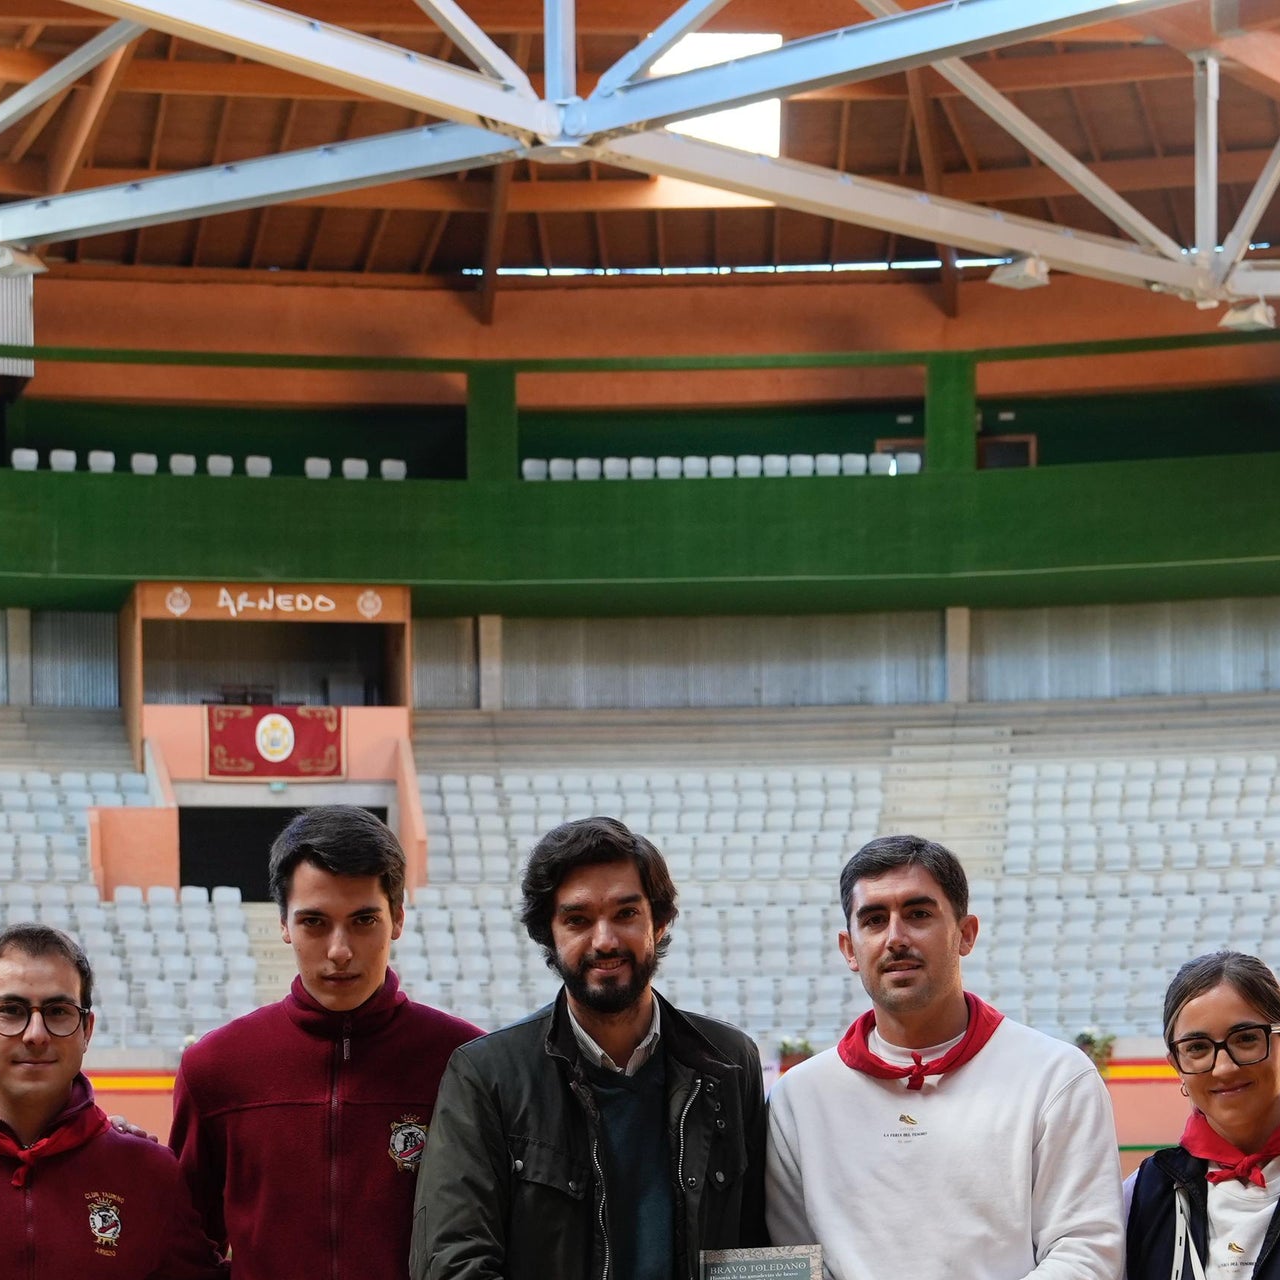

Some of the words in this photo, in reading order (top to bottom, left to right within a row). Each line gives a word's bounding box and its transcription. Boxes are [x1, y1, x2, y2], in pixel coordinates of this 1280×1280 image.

[216, 586, 336, 617] ARNEDO
[84, 1191, 100, 1200] CLUB
[710, 1265, 747, 1274] BRAVO
[749, 1262, 807, 1272] TOLEDANO
